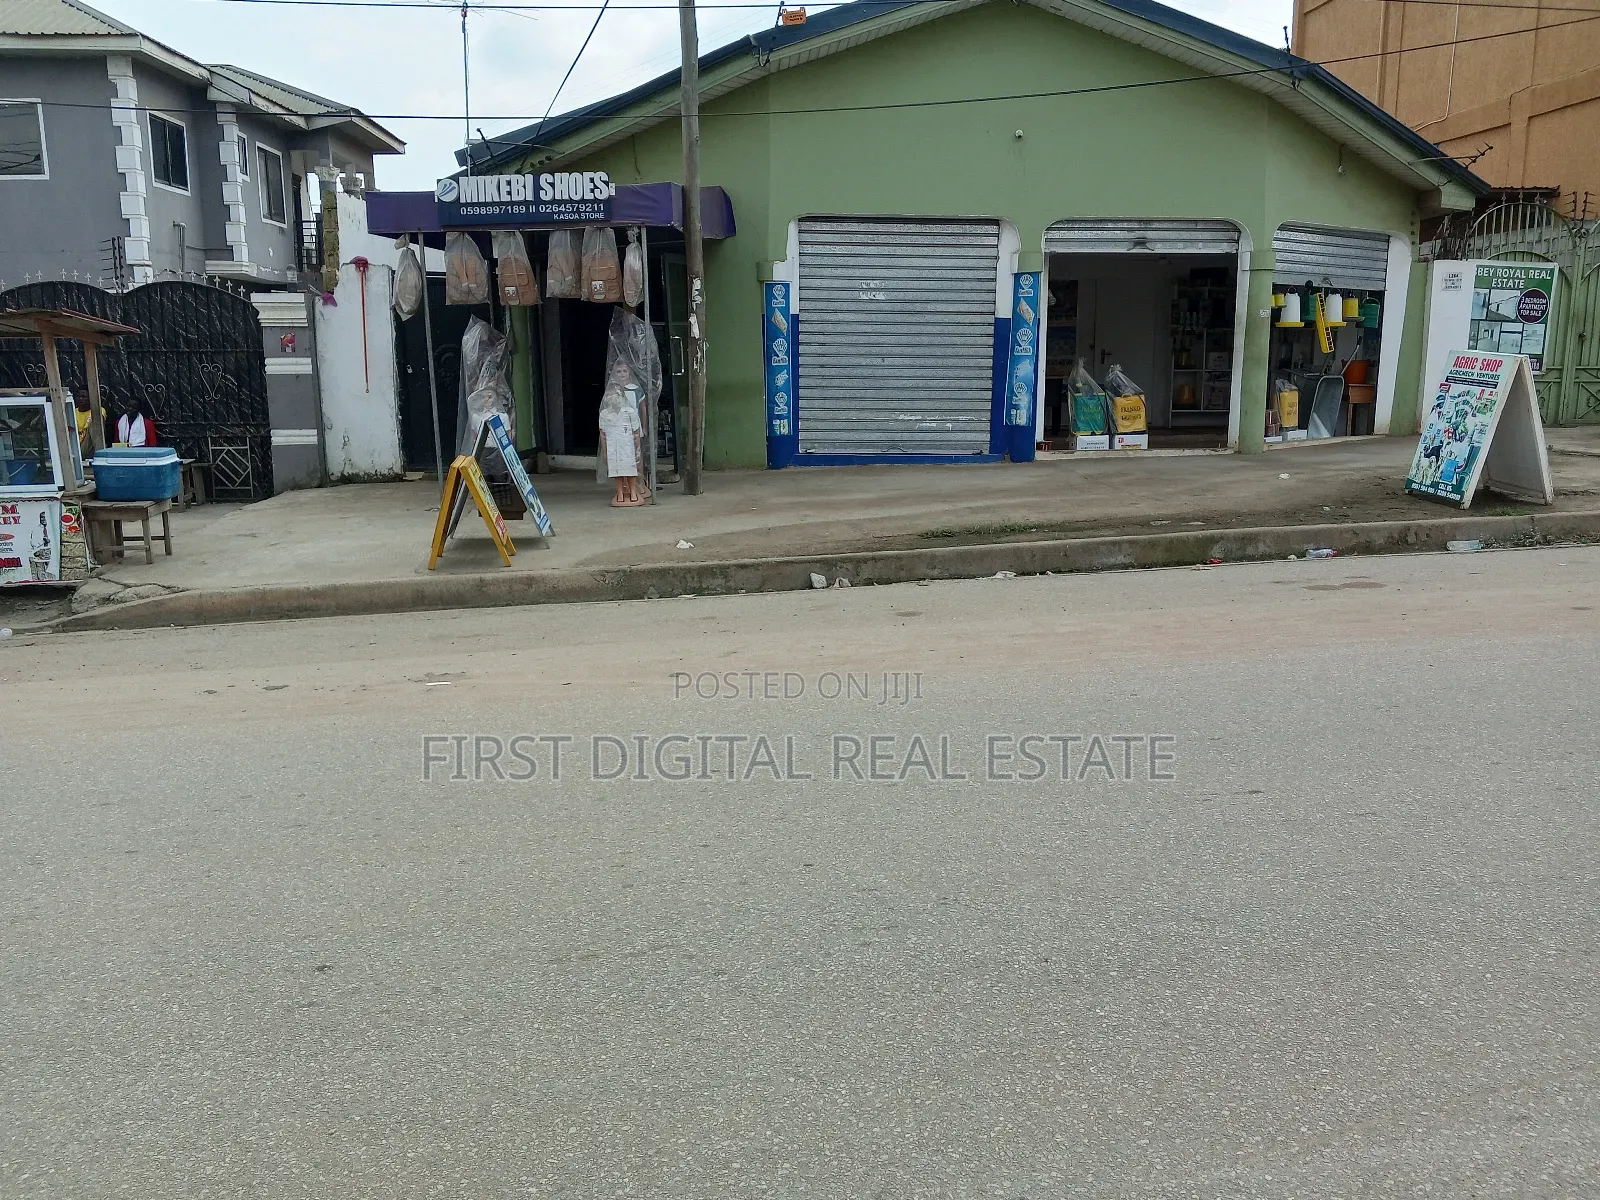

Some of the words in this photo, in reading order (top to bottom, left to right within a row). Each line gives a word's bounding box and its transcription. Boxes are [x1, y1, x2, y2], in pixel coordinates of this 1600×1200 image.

[459, 174, 534, 203] MIKEBI
[539, 171, 610, 201] SHOES
[460, 205, 526, 215] 0598997189
[539, 203, 604, 213] 0264579211
[580, 212, 605, 220] STORE
[1496, 268, 1526, 279] ROYAL
[1528, 269, 1552, 280] REAL
[1491, 278, 1525, 289] ESTATE
[1519, 302, 1547, 310] APARTMENT
[1453, 356, 1479, 369] AGRIC
[1479, 358, 1503, 372] SHOP
[1476, 372, 1500, 380] VENTURES
